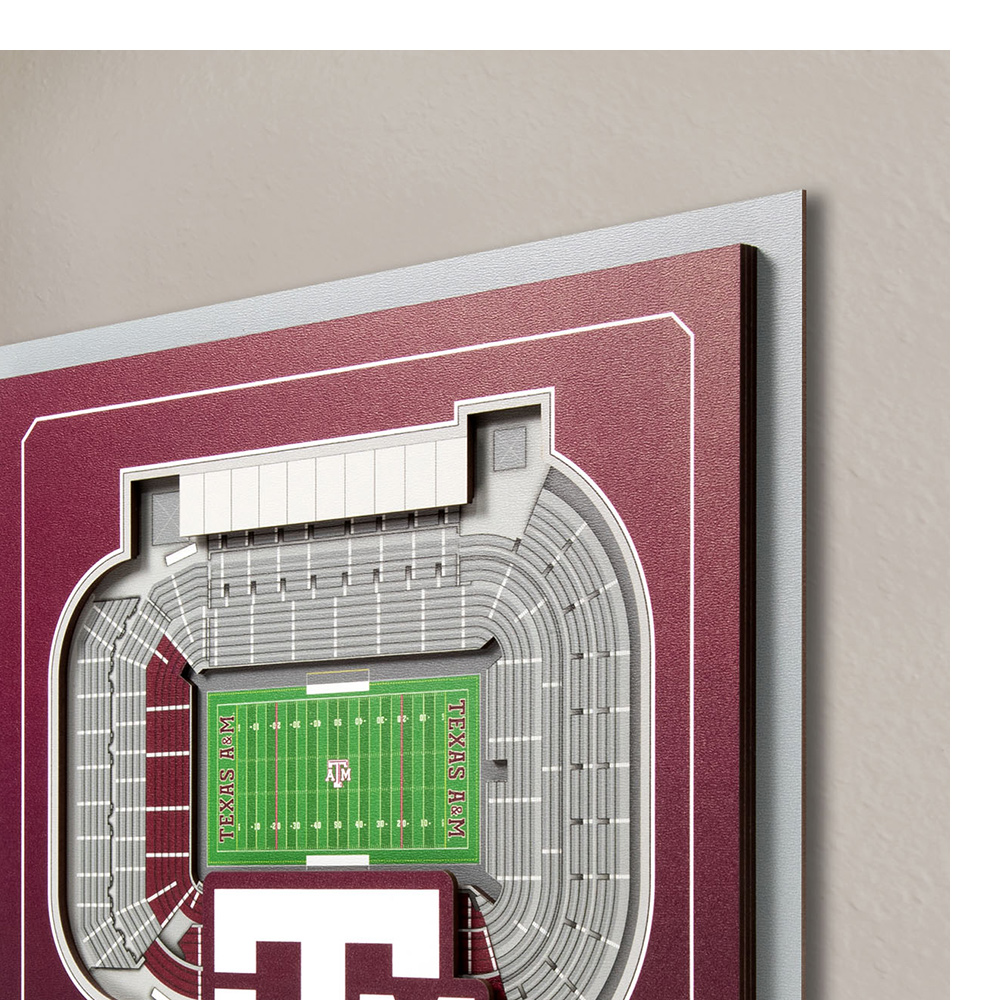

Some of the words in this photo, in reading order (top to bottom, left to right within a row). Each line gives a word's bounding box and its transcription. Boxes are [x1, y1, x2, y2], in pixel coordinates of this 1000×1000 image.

[219, 716, 235, 760] A&M
[447, 699, 466, 780] TEXAS
[219, 768, 235, 842] TEXAS
[447, 789, 466, 838] A&M
